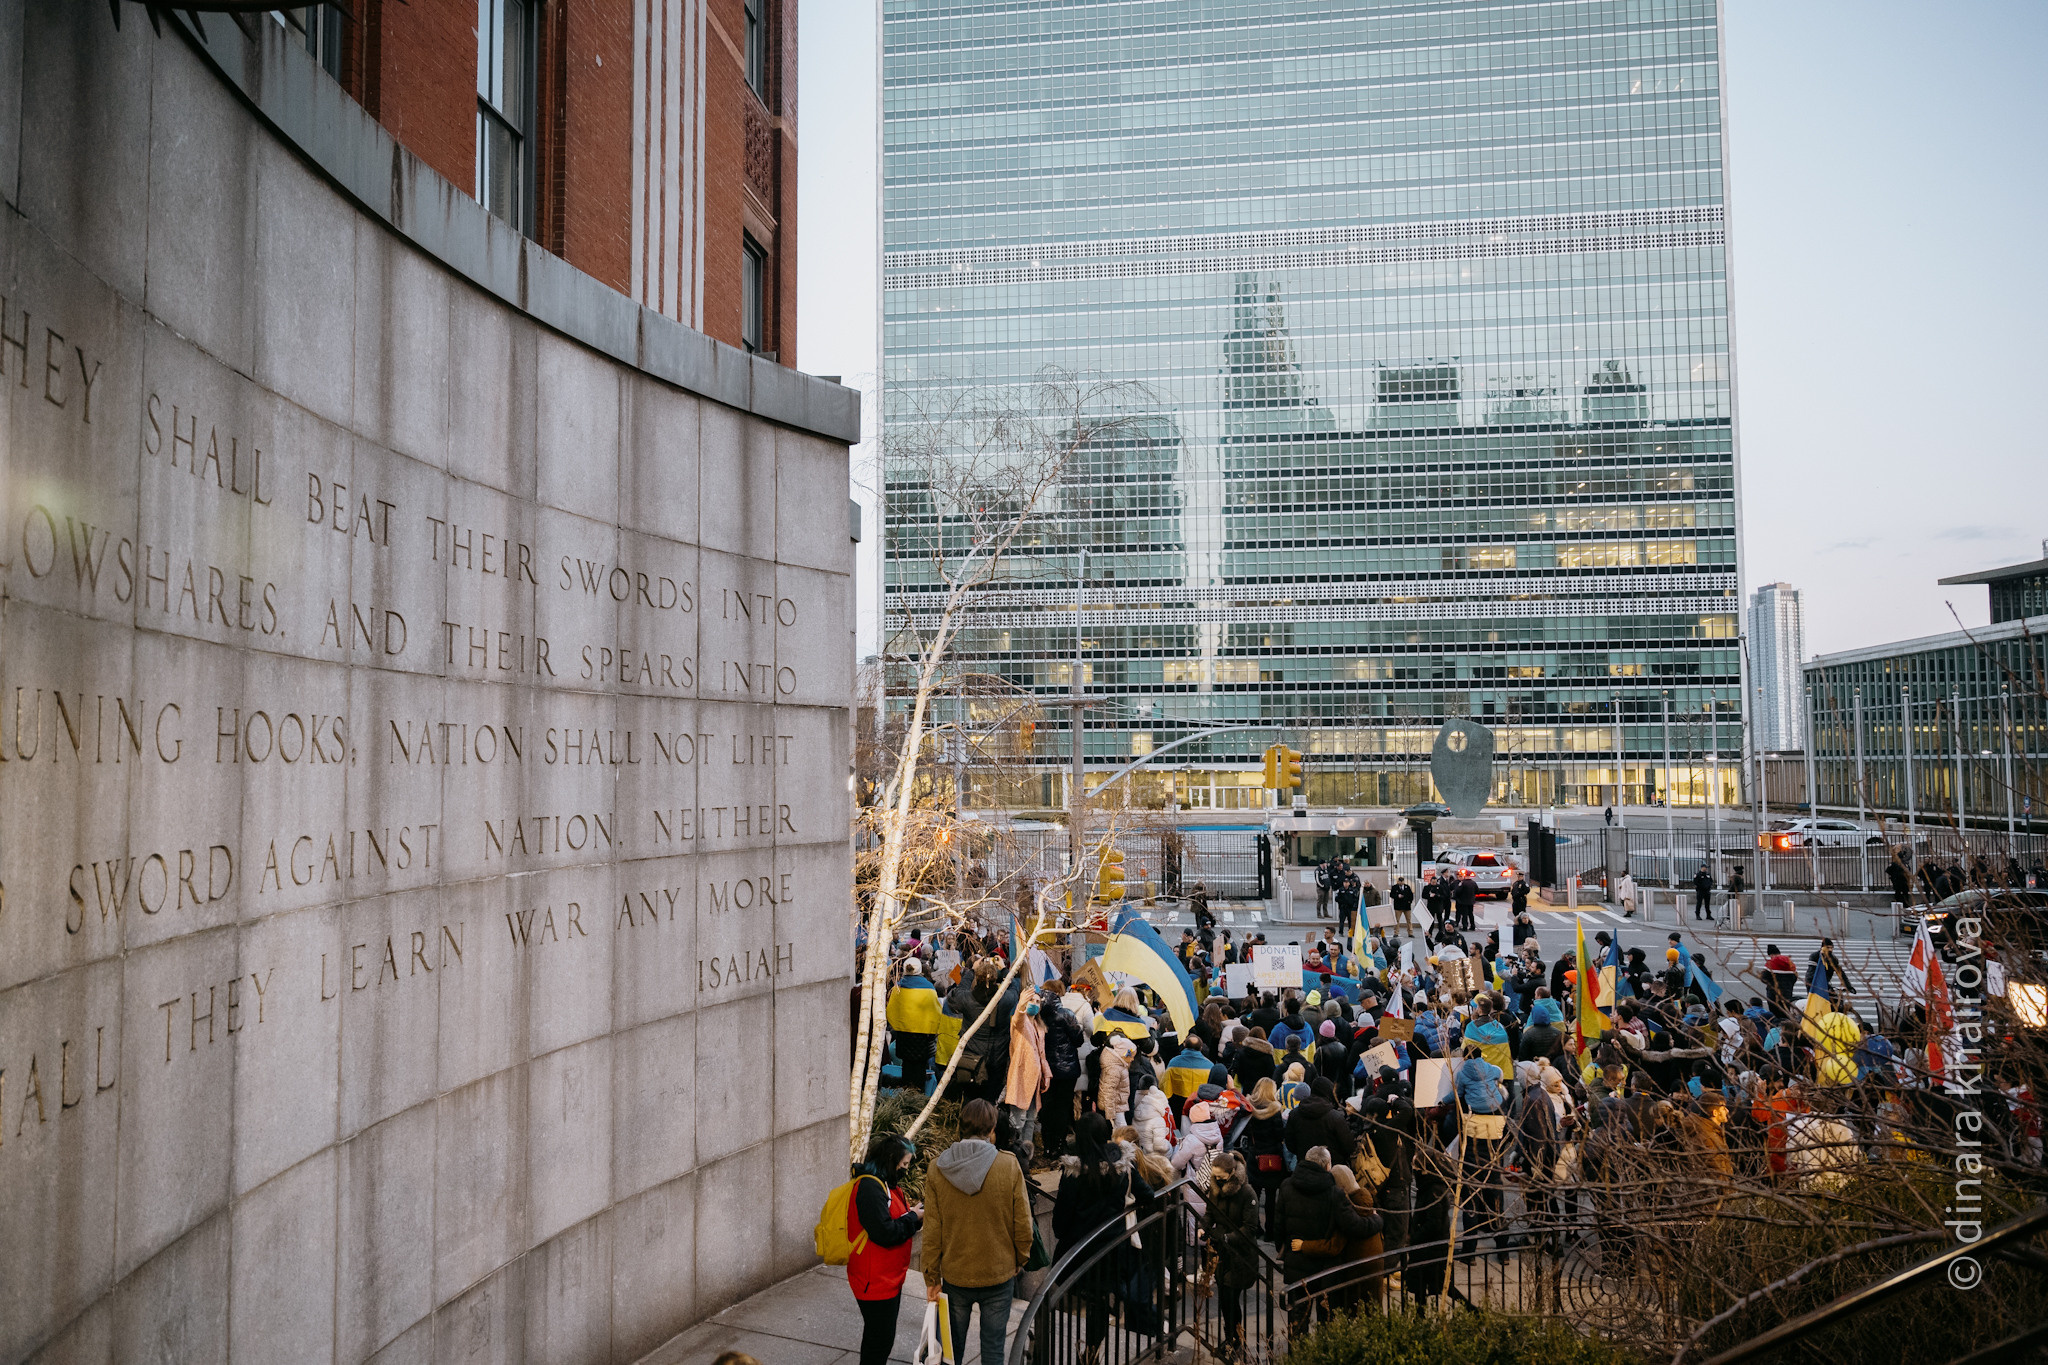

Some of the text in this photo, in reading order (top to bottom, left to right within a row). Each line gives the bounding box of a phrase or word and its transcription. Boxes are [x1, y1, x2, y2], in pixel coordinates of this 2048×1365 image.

[145, 393, 273, 506] SHALL
[307, 472, 397, 547] BEAT
[427, 516, 539, 585] THEIR
[560, 555, 694, 613] SWORDS
[722, 588, 797, 627] INTO
[0, 504, 797, 695] OWSHARES. AND THEIR SPEARS INTO
[0, 686, 794, 768] UNING HOOKS; NATION SHALL NOT LIFT
[65, 844, 233, 935] SWORD
[259, 824, 438, 894] AGAINST
[484, 812, 624, 861] NATION.
[653, 804, 798, 845] NEITHER
[0, 872, 795, 1147] ALL THEY LEARN WAR ANY MORE
[697, 942, 795, 993] ISAIAH
[1260, 946, 1300, 956] DONATE!
